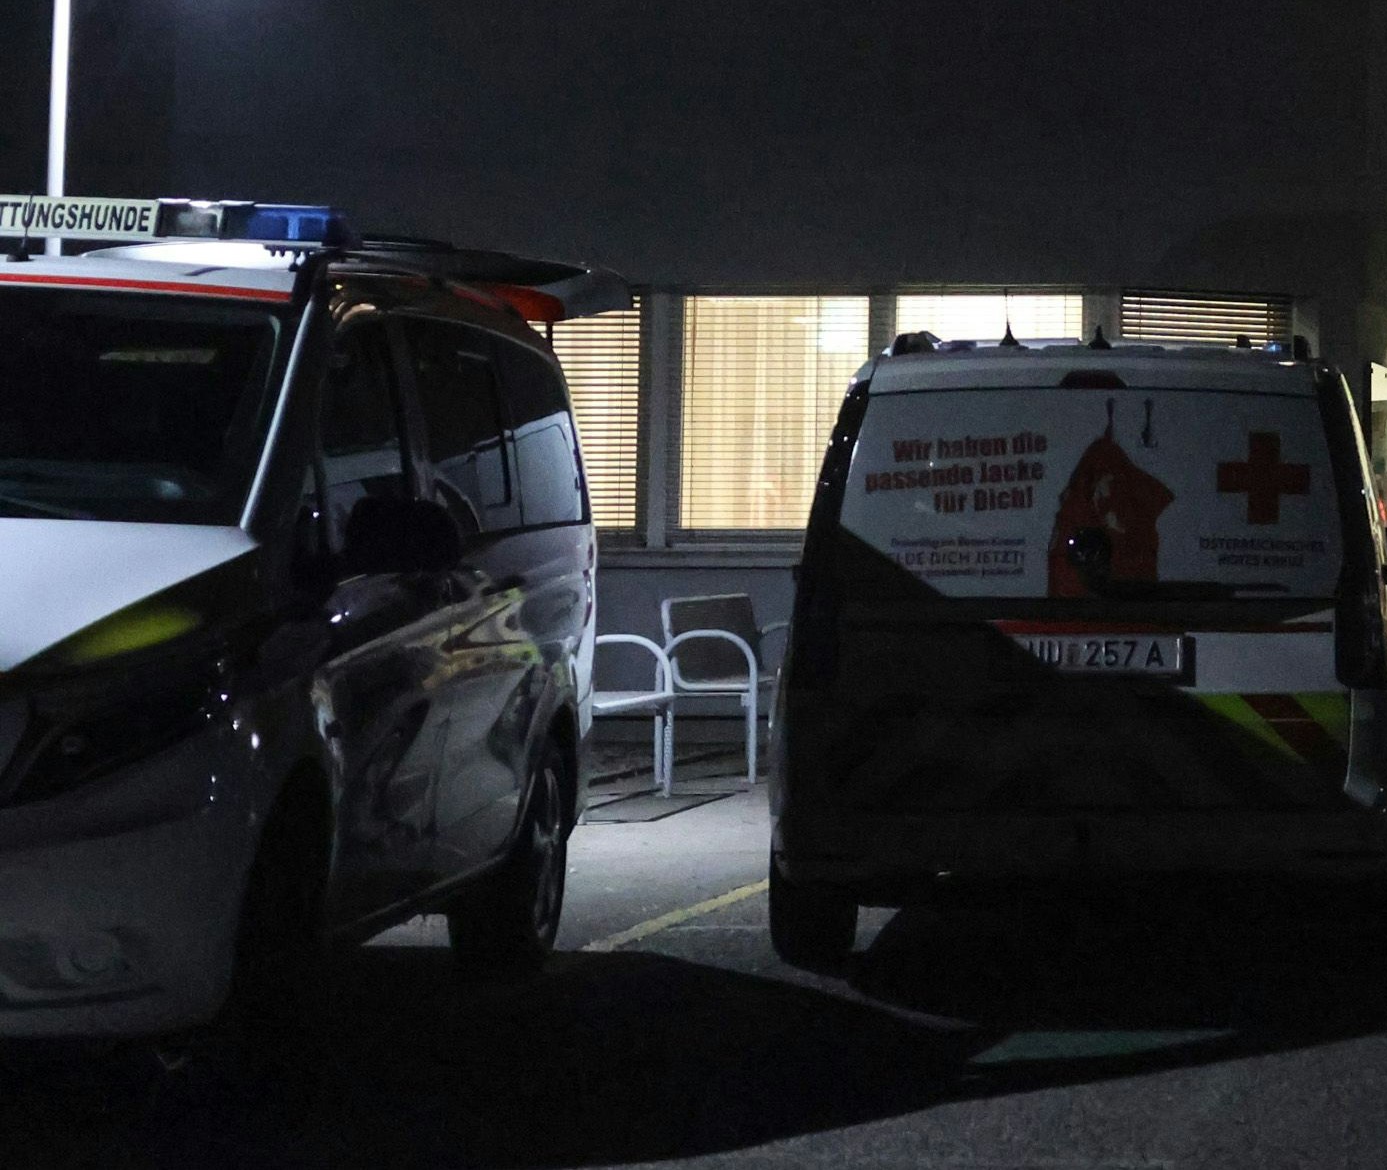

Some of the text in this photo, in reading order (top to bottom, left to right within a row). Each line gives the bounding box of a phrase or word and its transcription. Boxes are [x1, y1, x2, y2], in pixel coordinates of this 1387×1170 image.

[893, 432, 1047, 462] Wir haben die
[865, 459, 1045, 494] passende Jacke
[933, 485, 1034, 513] für Dich!
[931, 550, 970, 565] DICH
[1085, 640, 1137, 667] 257
[1145, 640, 1164, 667] A
